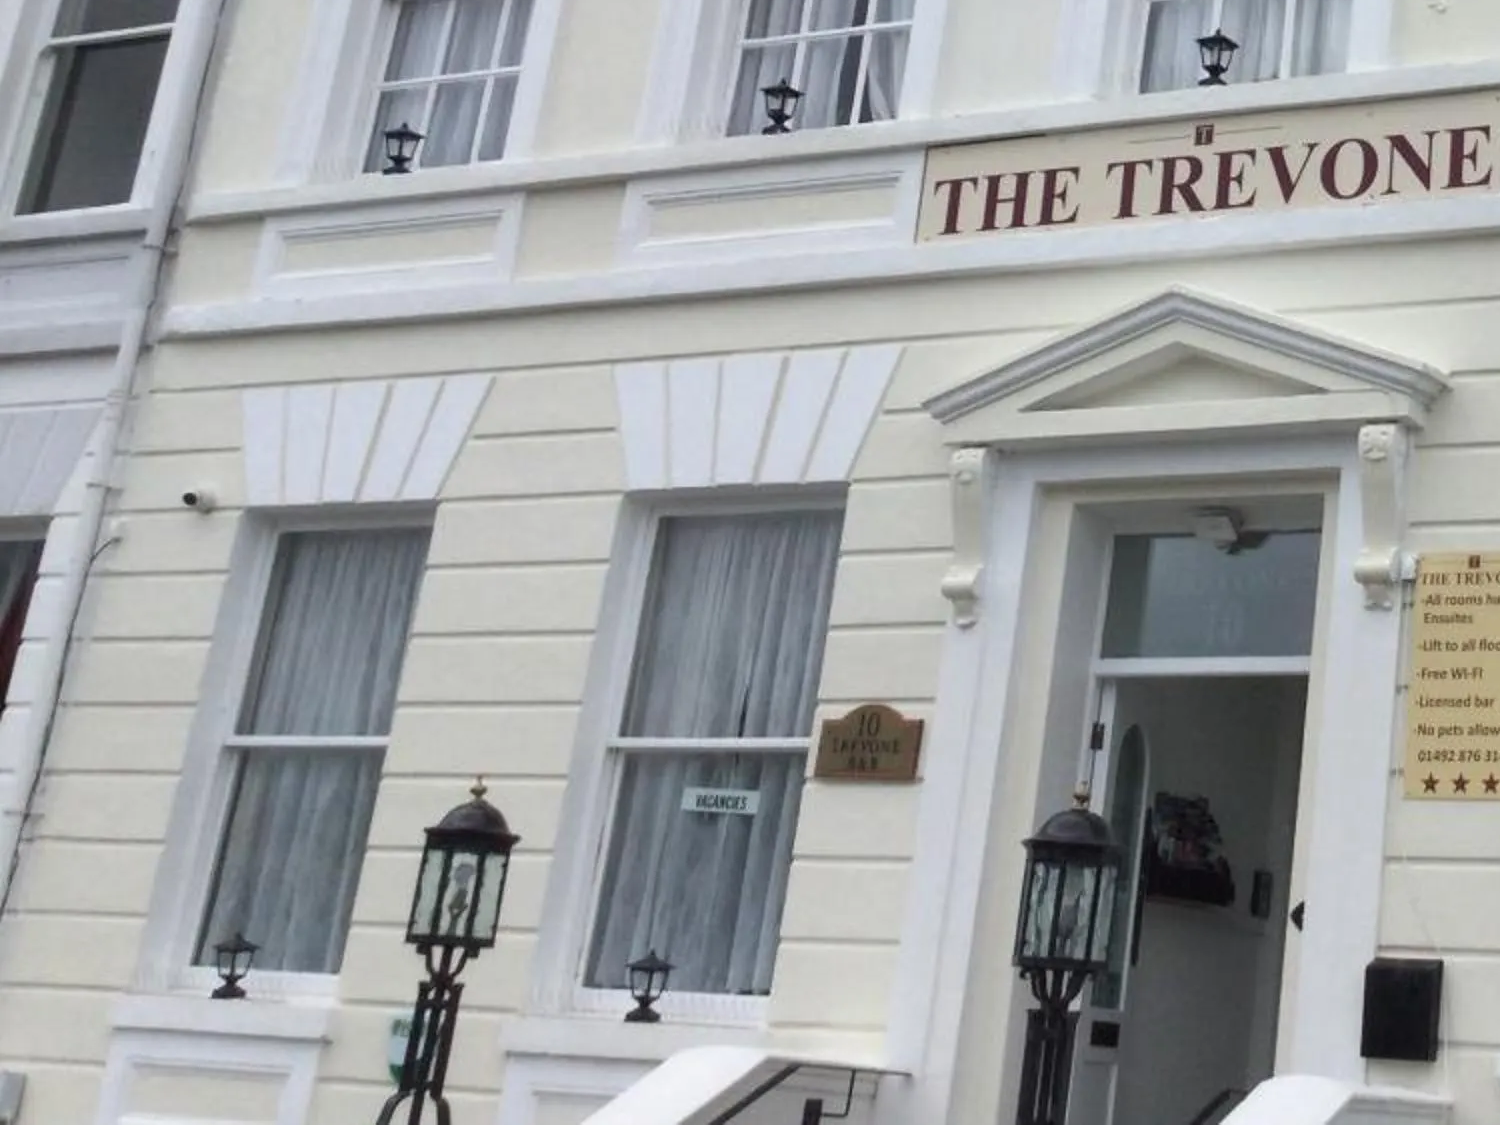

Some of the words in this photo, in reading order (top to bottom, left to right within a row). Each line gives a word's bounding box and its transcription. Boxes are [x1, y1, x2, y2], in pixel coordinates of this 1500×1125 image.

[934, 166, 1080, 236] THE
[1107, 125, 1493, 219] TREVONE
[1422, 572, 1448, 586] THE
[1445, 595, 1482, 606] rooms
[1446, 639, 1459, 652] to
[1461, 638, 1477, 652] all
[1474, 695, 1495, 708] bar
[858, 713, 881, 737] 10
[1437, 724, 1464, 739] pets
